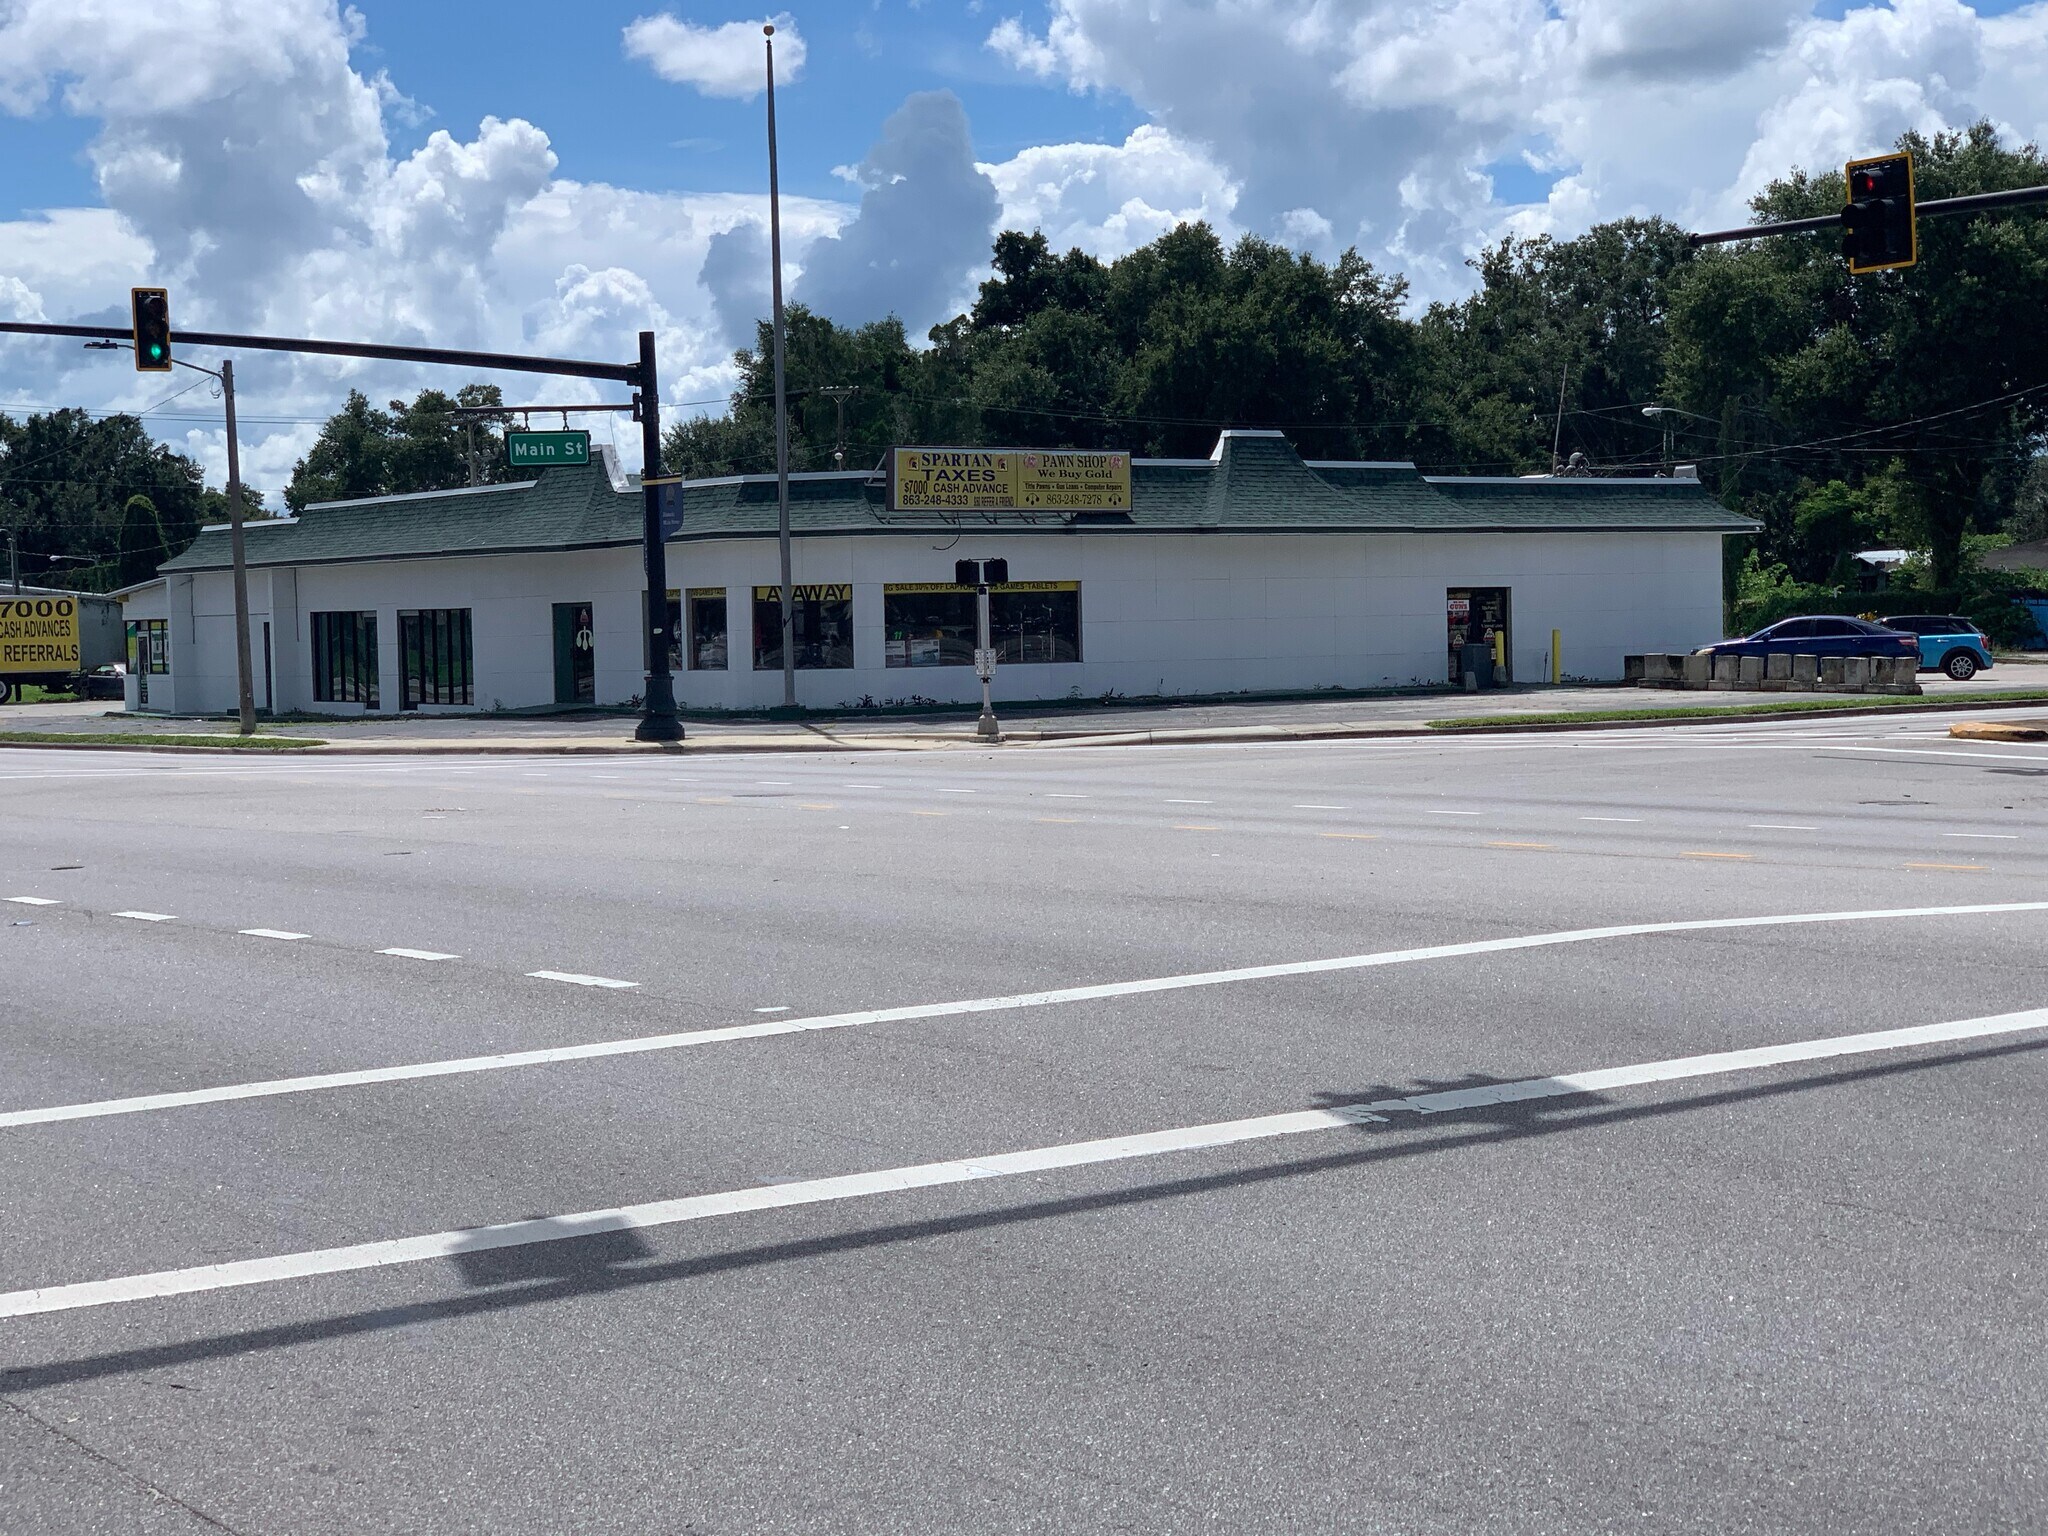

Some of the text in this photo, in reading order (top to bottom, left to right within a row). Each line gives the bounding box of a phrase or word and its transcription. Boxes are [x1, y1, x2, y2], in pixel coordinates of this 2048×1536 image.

[515, 442, 582, 456] Main St
[921, 453, 992, 467] SPARTAN
[1042, 455, 1106, 468] PAWN SHOP
[921, 469, 996, 482] TAXES
[1037, 469, 1112, 479] We Buy Gold
[904, 480, 1009, 495] $7000 CASH ADVANCE
[902, 494, 969, 506] 863-248-4333
[1046, 494, 1103, 505] 863-248-7278
[0, 600, 73, 618] 7000
[24, 620, 71, 637] ADVANCES
[4, 644, 79, 662] REFERRALS
